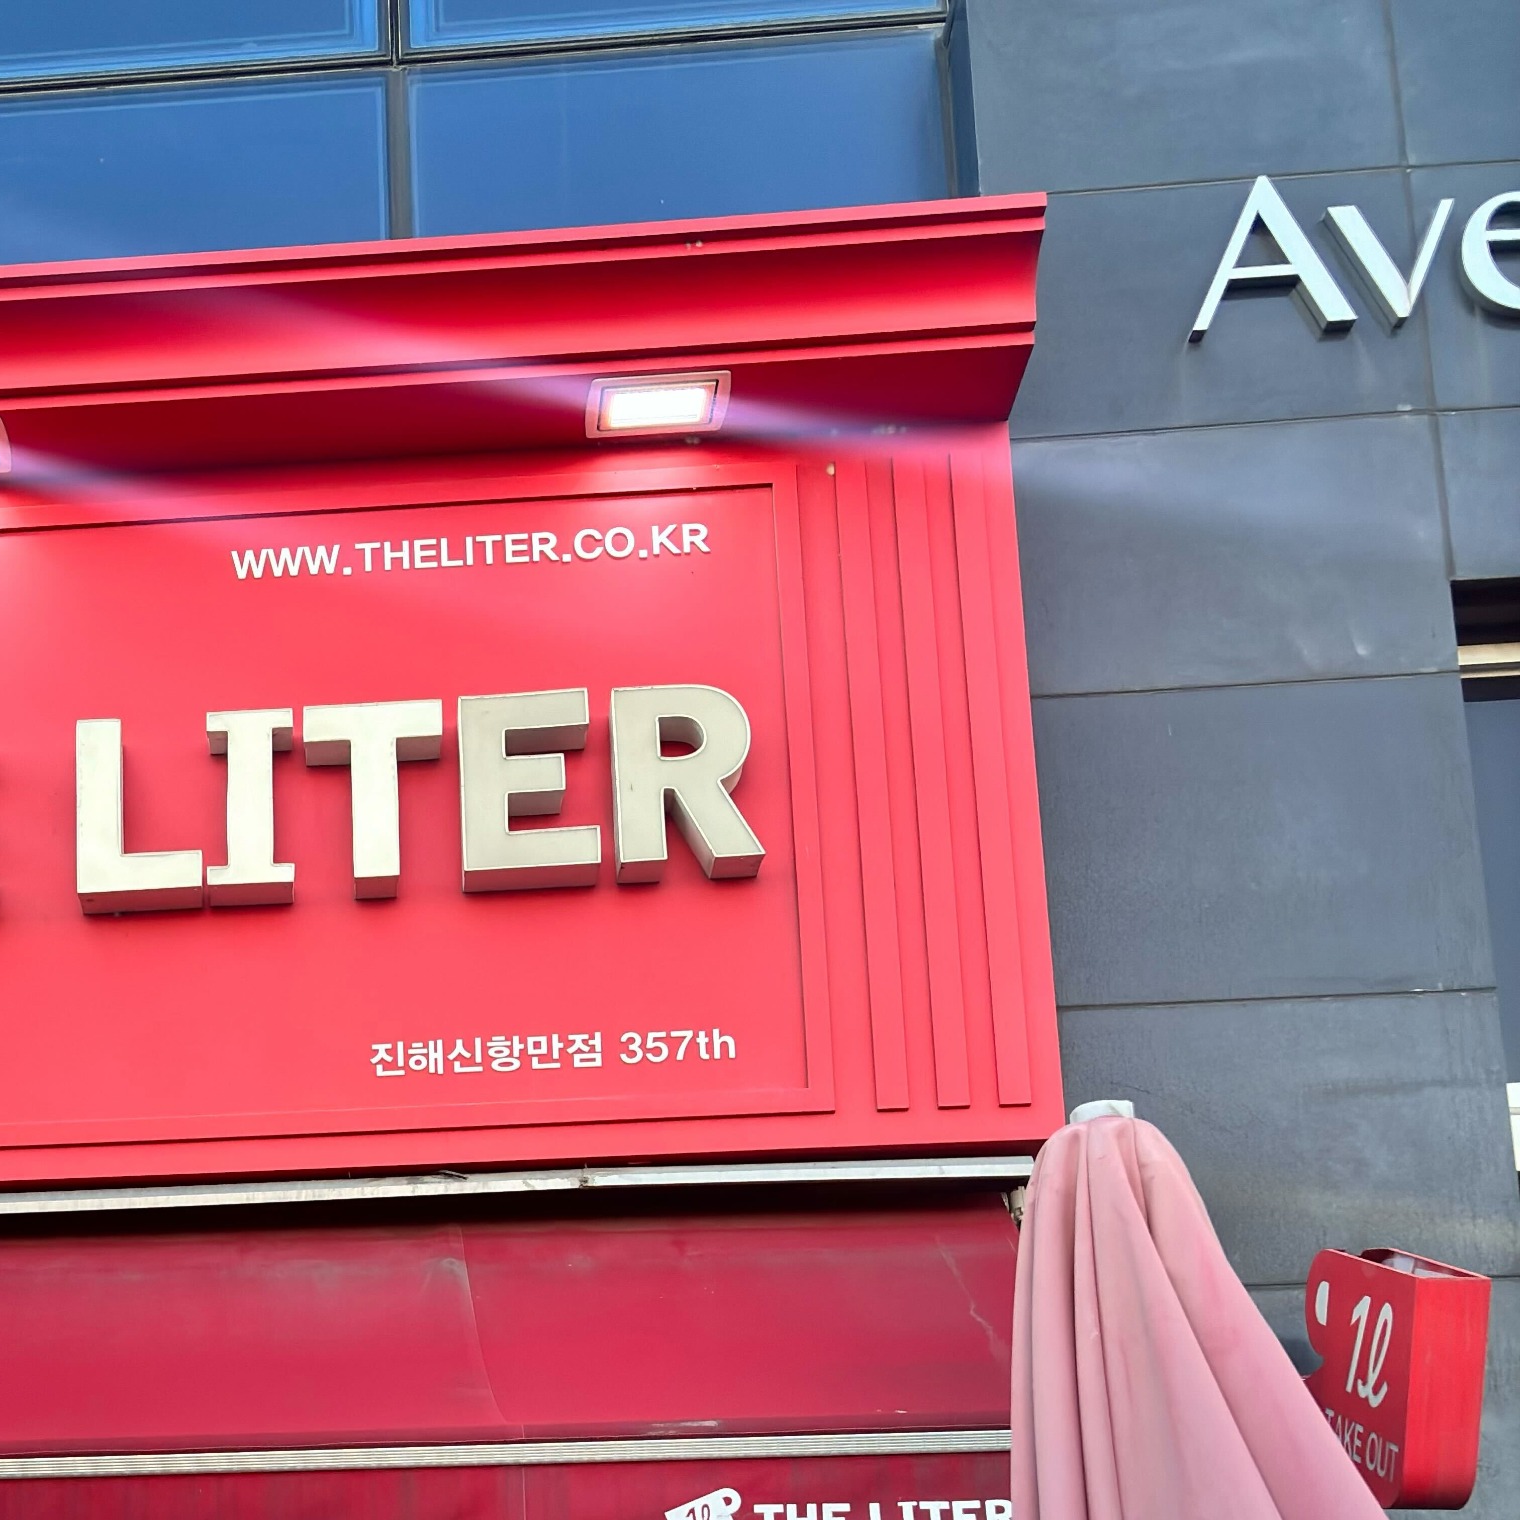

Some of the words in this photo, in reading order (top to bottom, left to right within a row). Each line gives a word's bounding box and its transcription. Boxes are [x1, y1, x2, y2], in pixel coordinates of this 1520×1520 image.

[232, 522, 711, 581] WWW.THELITER.CO.KR
[75, 684, 766, 915] LITER
[370, 1031, 604, 1077] 진해신항만점
[620, 1028, 737, 1066] 357th
[1365, 1432, 1399, 1483] OUT
